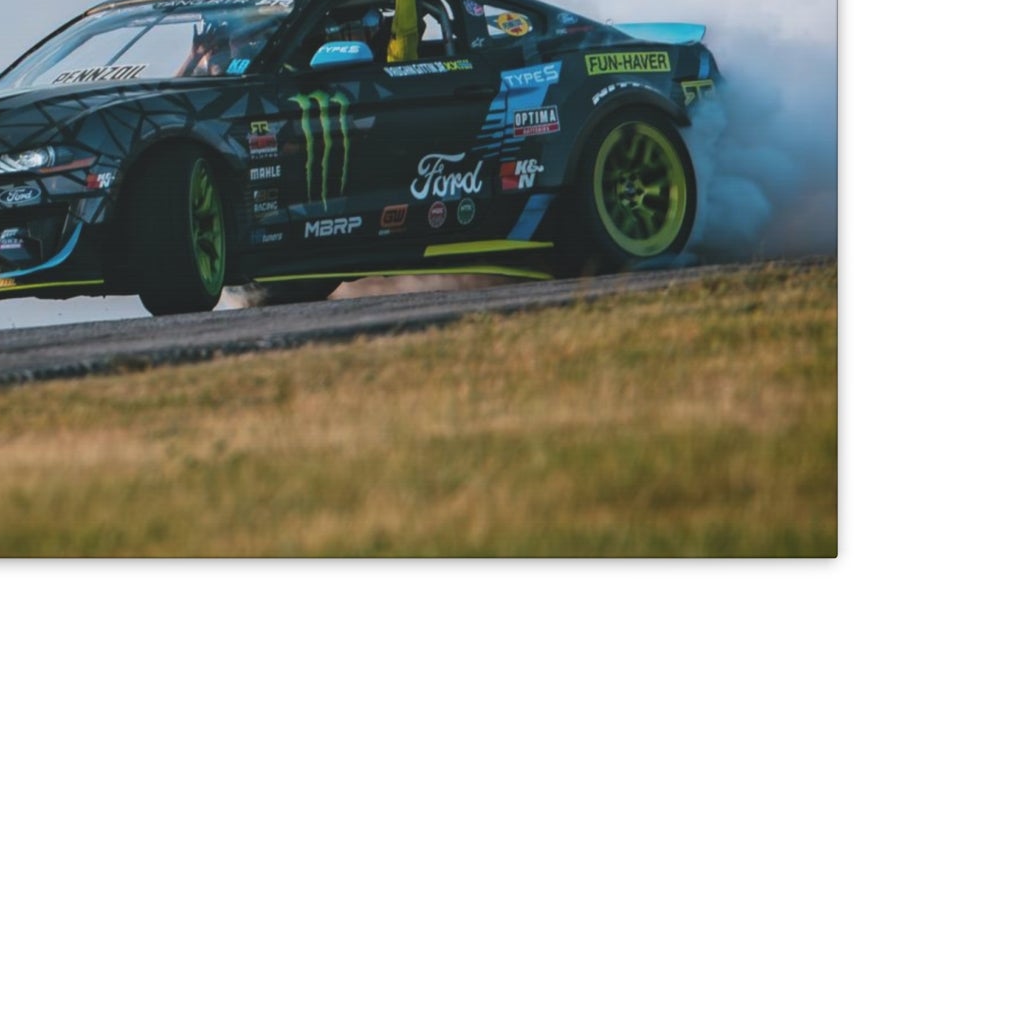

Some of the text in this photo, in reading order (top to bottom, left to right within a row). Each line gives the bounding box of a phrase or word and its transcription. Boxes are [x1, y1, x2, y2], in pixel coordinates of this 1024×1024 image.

[589, 56, 668, 73] FUN-HAVER
[515, 108, 557, 126] OPTIMA
[250, 166, 281, 180] MAHLE
[410, 152, 483, 200] Ford
[6, 189, 33, 202] Ford
[304, 216, 363, 238] MBRP
